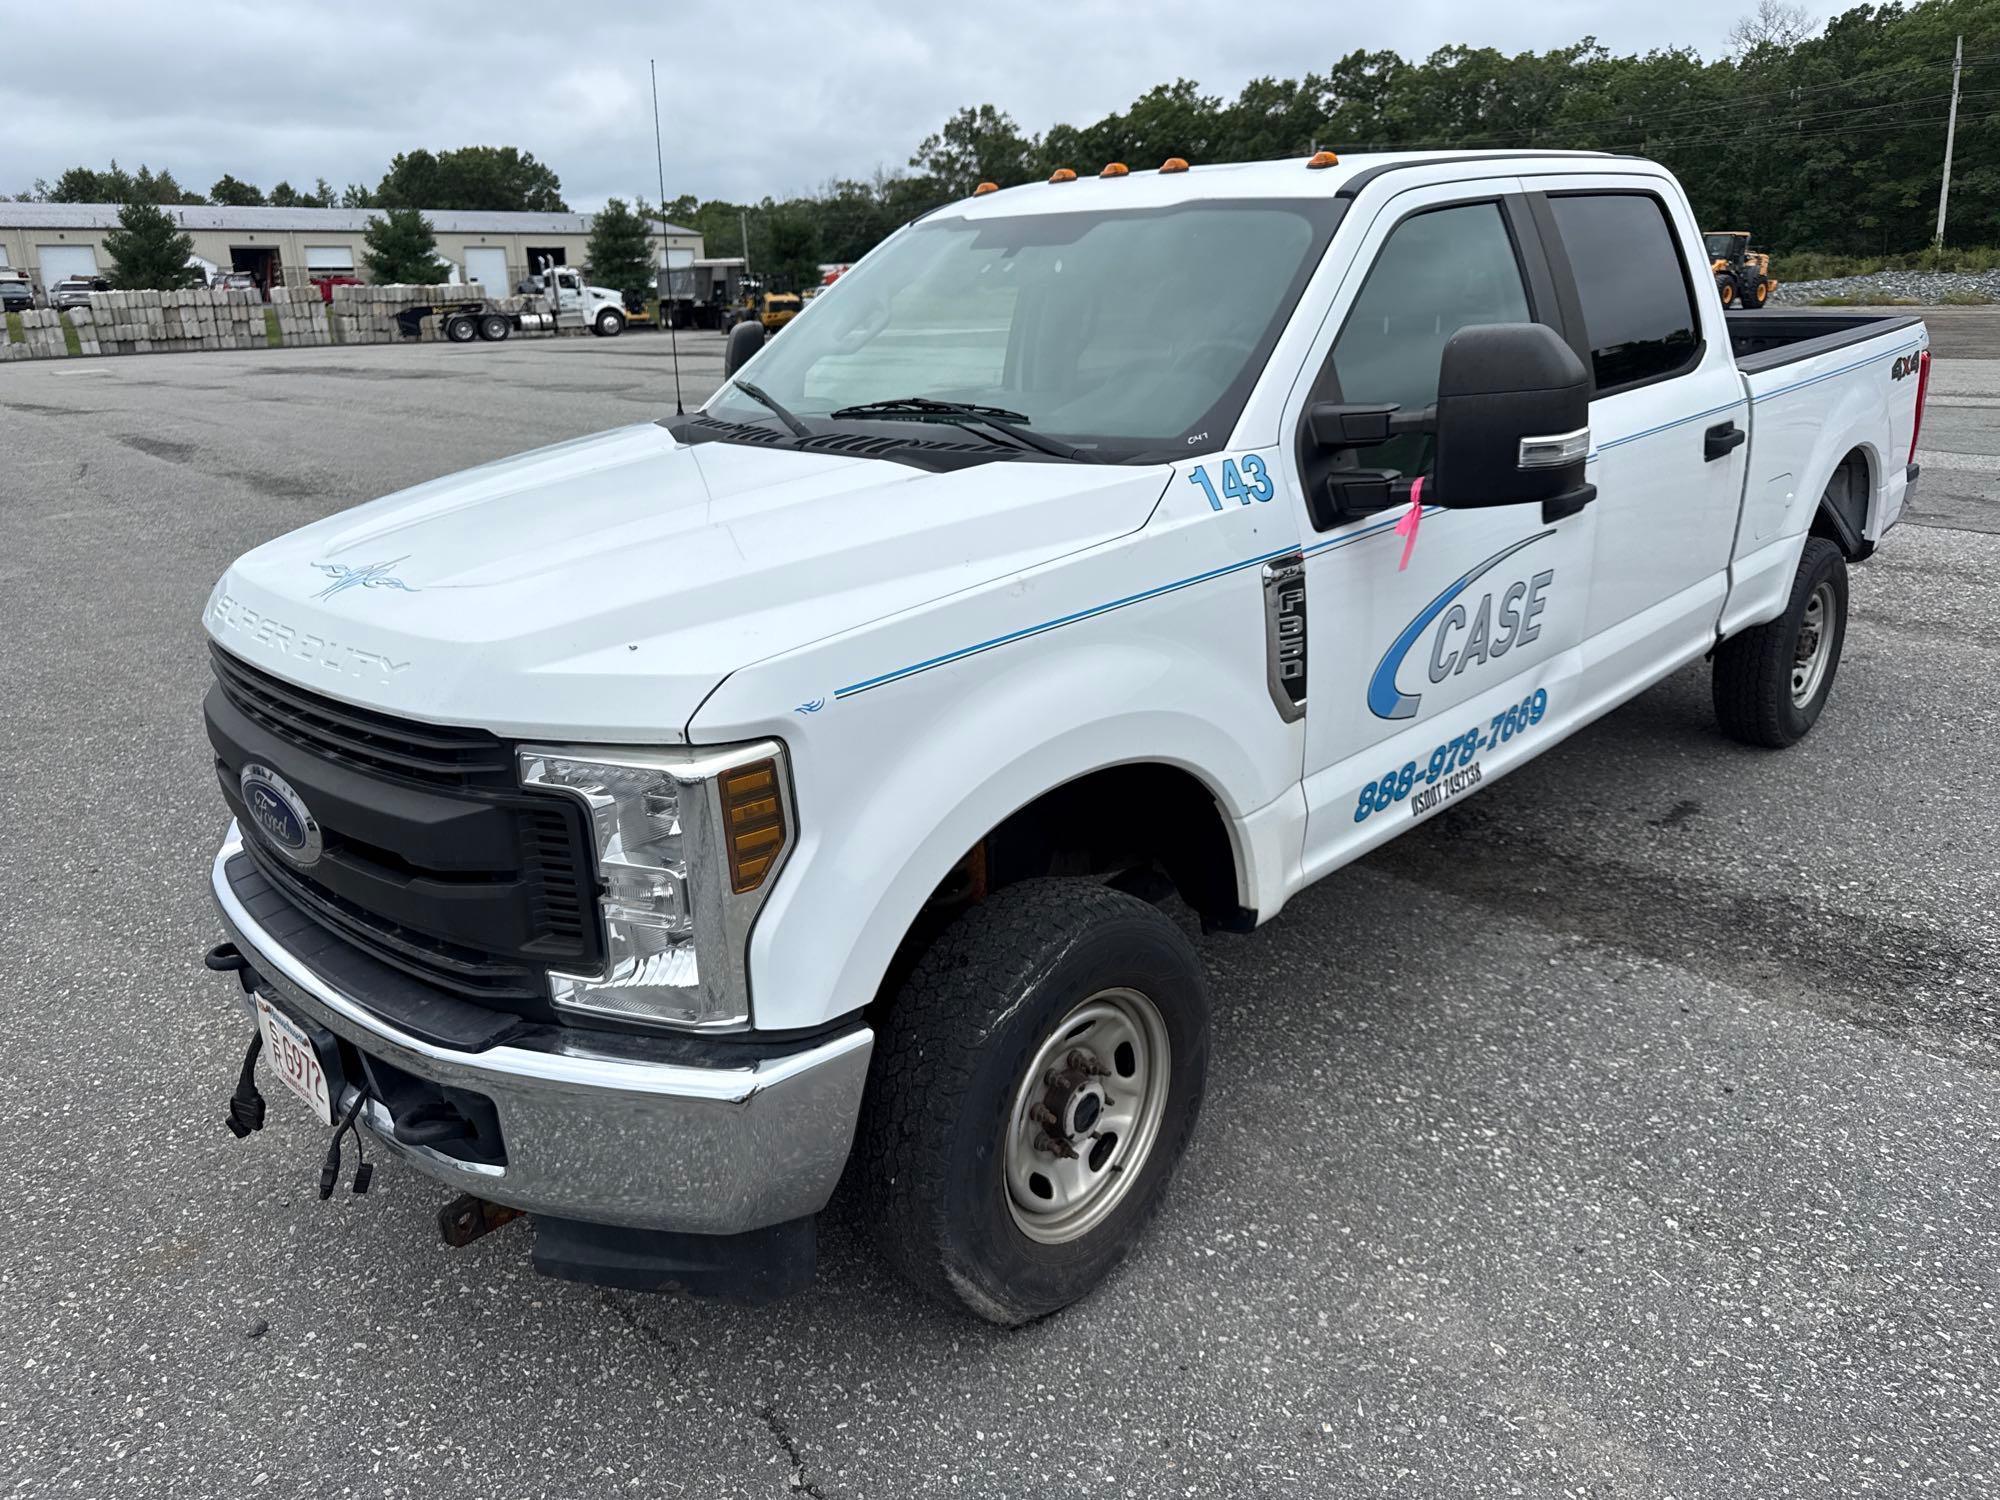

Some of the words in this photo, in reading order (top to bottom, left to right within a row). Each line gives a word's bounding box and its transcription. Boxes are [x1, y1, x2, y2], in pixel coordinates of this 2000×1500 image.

[1891, 350, 1920, 381] 4x4
[1188, 454, 1274, 512] 143
[208, 592, 296, 653] SUPER
[293, 633, 412, 686] DUTY
[1279, 587, 1304, 680] F350
[1428, 568, 1554, 684] CASE
[1354, 688, 1547, 823] 888-978-7669
[1411, 782, 1442, 817] USDOT
[1443, 762, 1483, 801] 2492138
[253, 790, 291, 840] Ford
